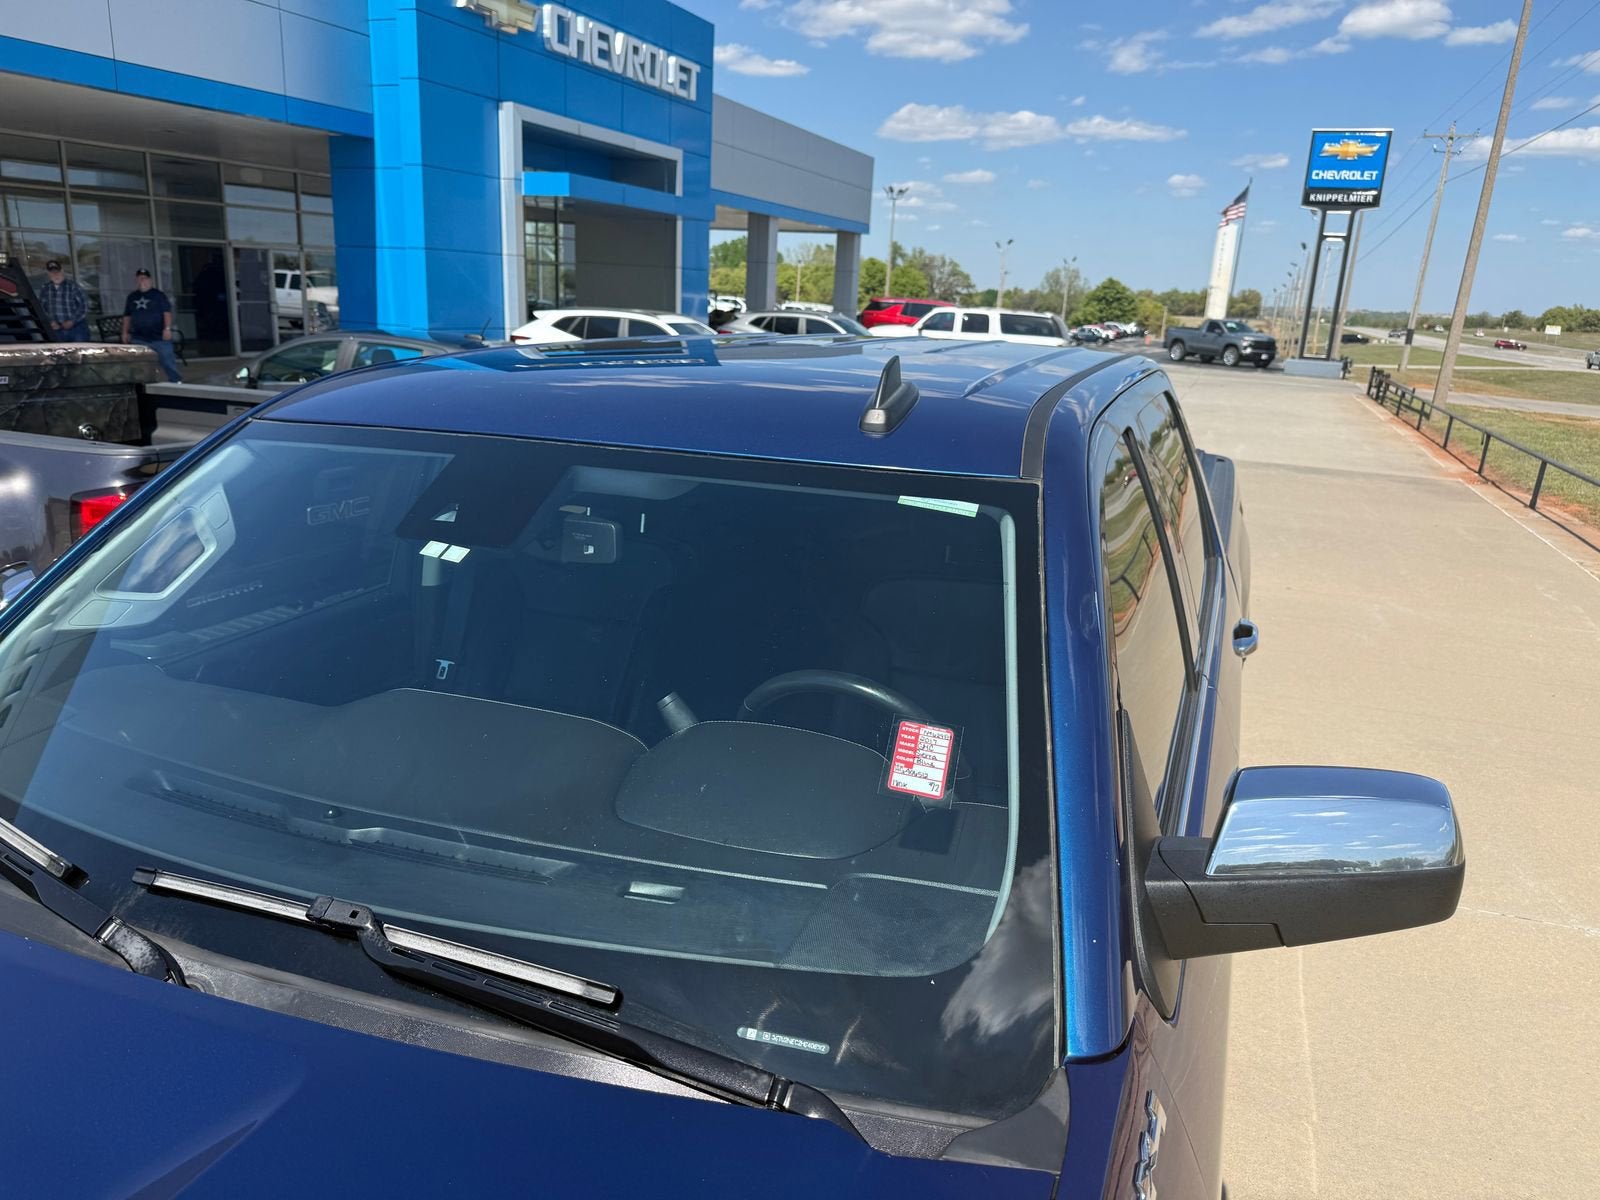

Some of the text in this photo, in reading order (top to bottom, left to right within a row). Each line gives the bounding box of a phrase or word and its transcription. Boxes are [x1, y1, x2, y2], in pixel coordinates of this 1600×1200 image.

[543, 4, 700, 101] CHEVROLET
[1311, 170, 1379, 180] CHEVROLET
[1309, 193, 1374, 203] KNIPPELMIER
[306, 496, 369, 526] GMC
